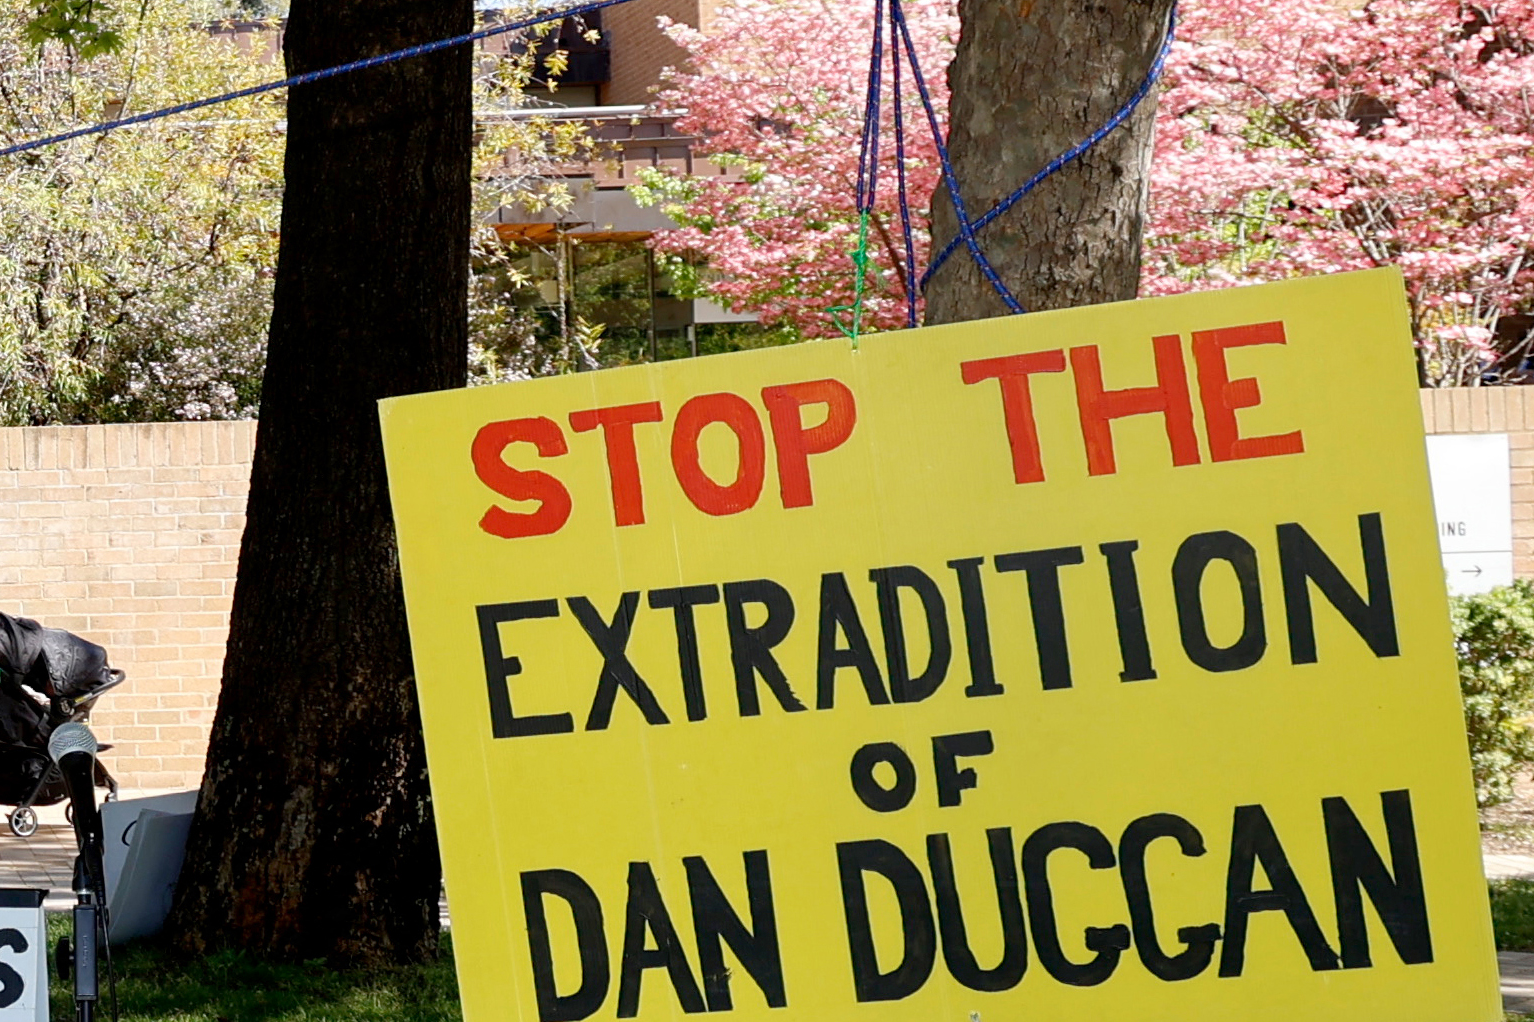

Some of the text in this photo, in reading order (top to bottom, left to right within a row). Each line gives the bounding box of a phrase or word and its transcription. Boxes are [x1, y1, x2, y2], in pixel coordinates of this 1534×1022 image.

[470, 320, 1305, 540] STOP THE
[475, 512, 1400, 740] EXTRADITION
[850, 730, 995, 813] OF
[836, 788, 1435, 1004] DUGGAN
